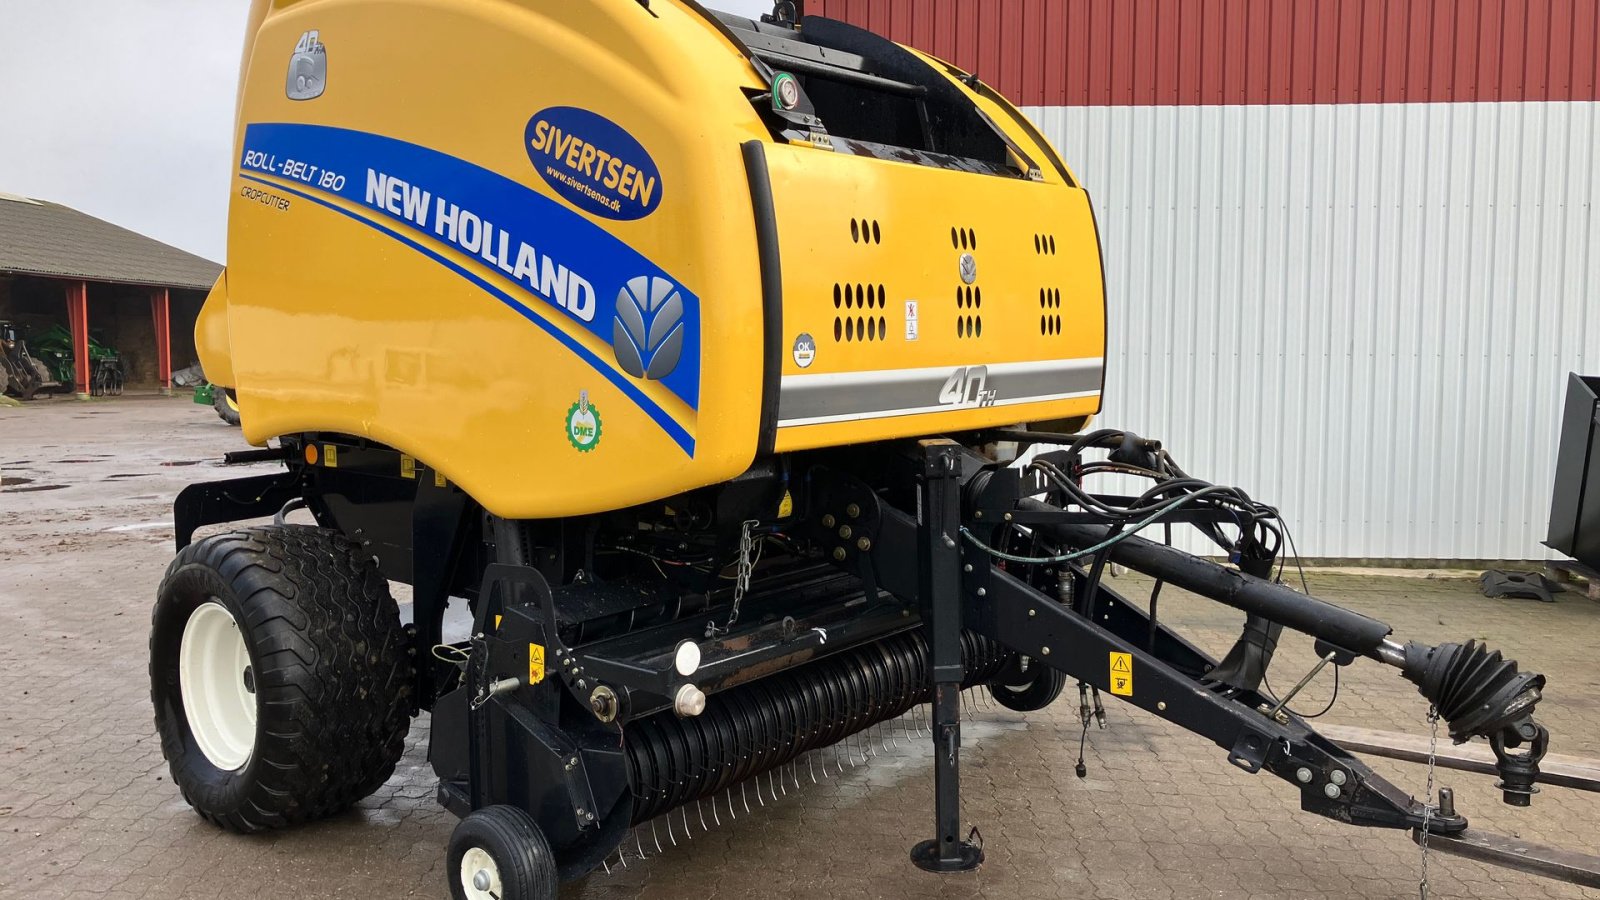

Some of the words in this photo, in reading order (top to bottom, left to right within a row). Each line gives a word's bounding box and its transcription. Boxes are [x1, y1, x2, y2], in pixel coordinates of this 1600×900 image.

[318, 169, 346, 191] 180
[531, 119, 655, 207] SIVERTSEN
[240, 186, 291, 211] CROPCUTTER
[546, 166, 621, 212] www.sivertsenas.dk
[365, 168, 431, 227] NEW
[435, 197, 596, 322] HOLLAND
[798, 341, 810, 351] OK
